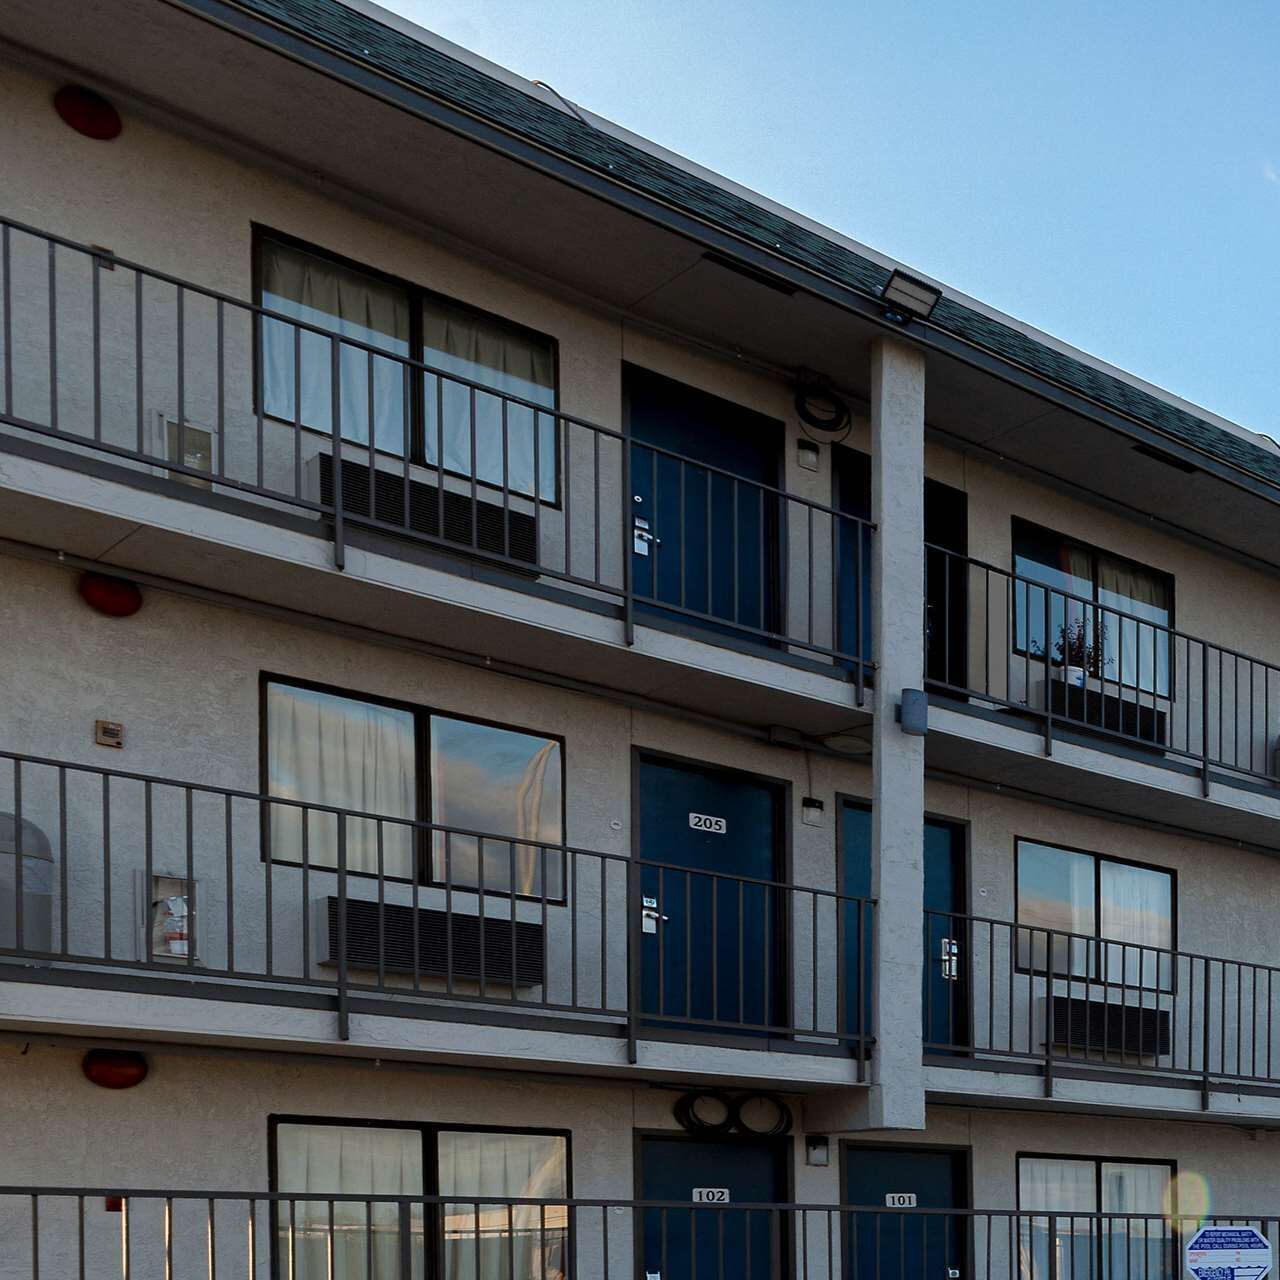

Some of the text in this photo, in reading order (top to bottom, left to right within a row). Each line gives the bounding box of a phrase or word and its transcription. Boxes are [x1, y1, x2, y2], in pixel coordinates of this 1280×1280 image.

[693, 815, 723, 832] 205
[697, 1190, 726, 1202] 102
[889, 1195, 914, 1206] 101
